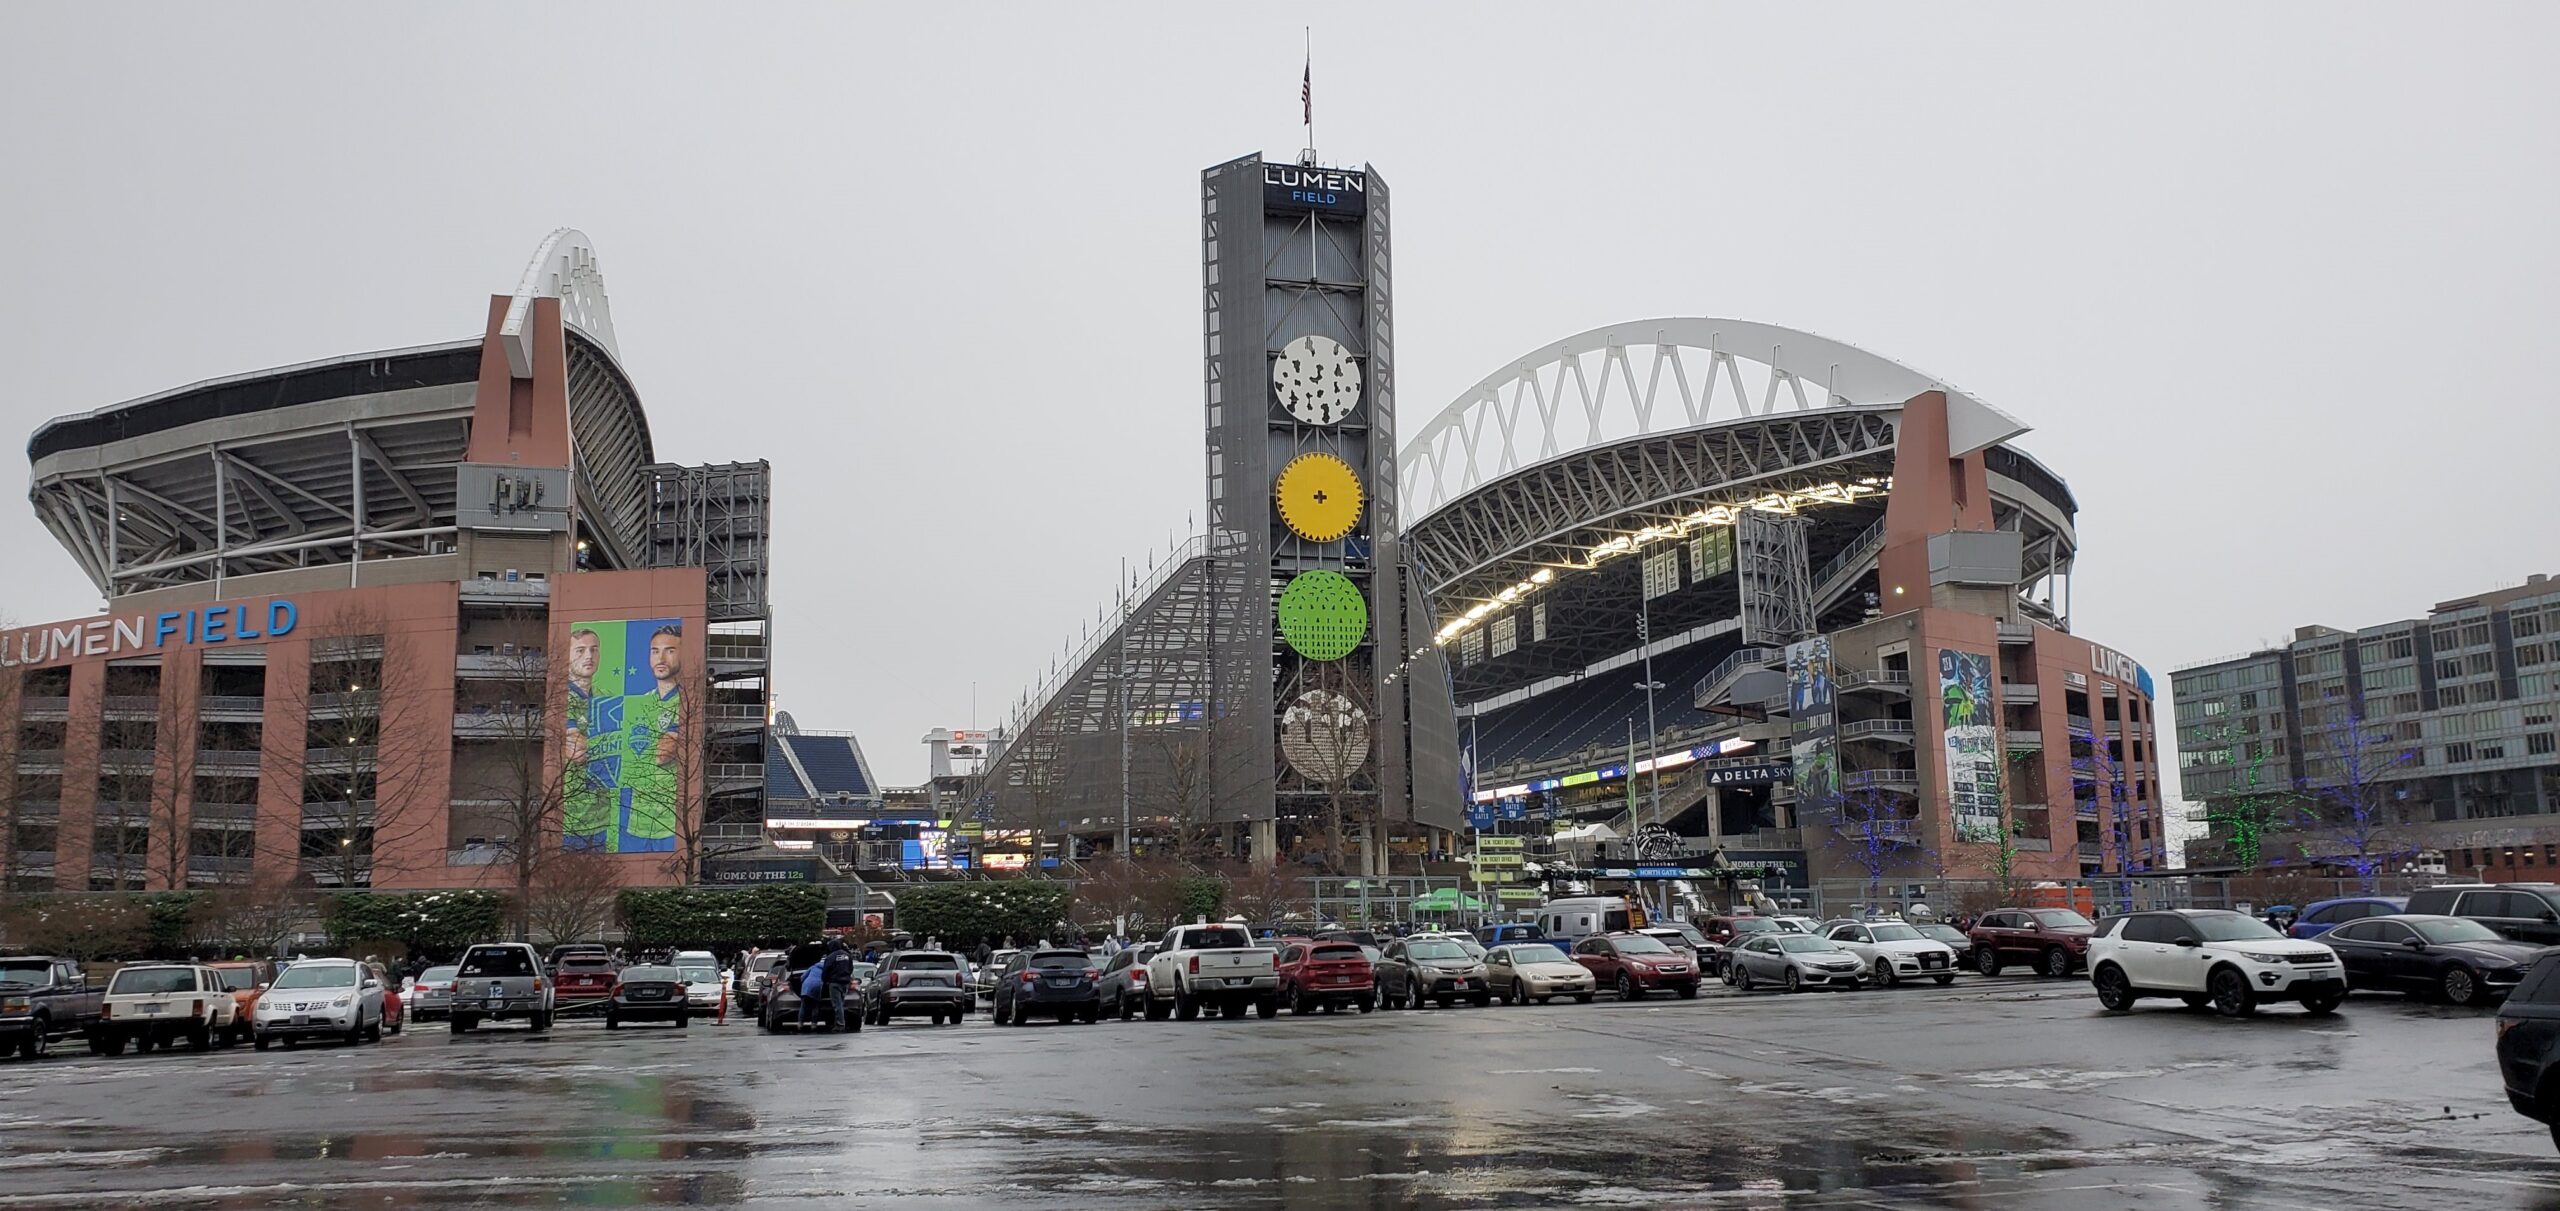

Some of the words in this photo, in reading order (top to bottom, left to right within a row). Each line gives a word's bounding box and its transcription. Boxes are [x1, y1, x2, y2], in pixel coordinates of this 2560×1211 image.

[1264, 168, 1363, 192] LUMEN
[1292, 190, 1337, 204] FIELD
[0, 615, 145, 668] LUMEN
[155, 600, 298, 648] FIELD
[1724, 769, 1769, 781] DELTA
[1774, 767, 1793, 778] SKY
[749, 871, 763, 880] OF
[763, 871, 786, 879] THE
[787, 870, 804, 879] 12s
[488, 986, 503, 998] 12
